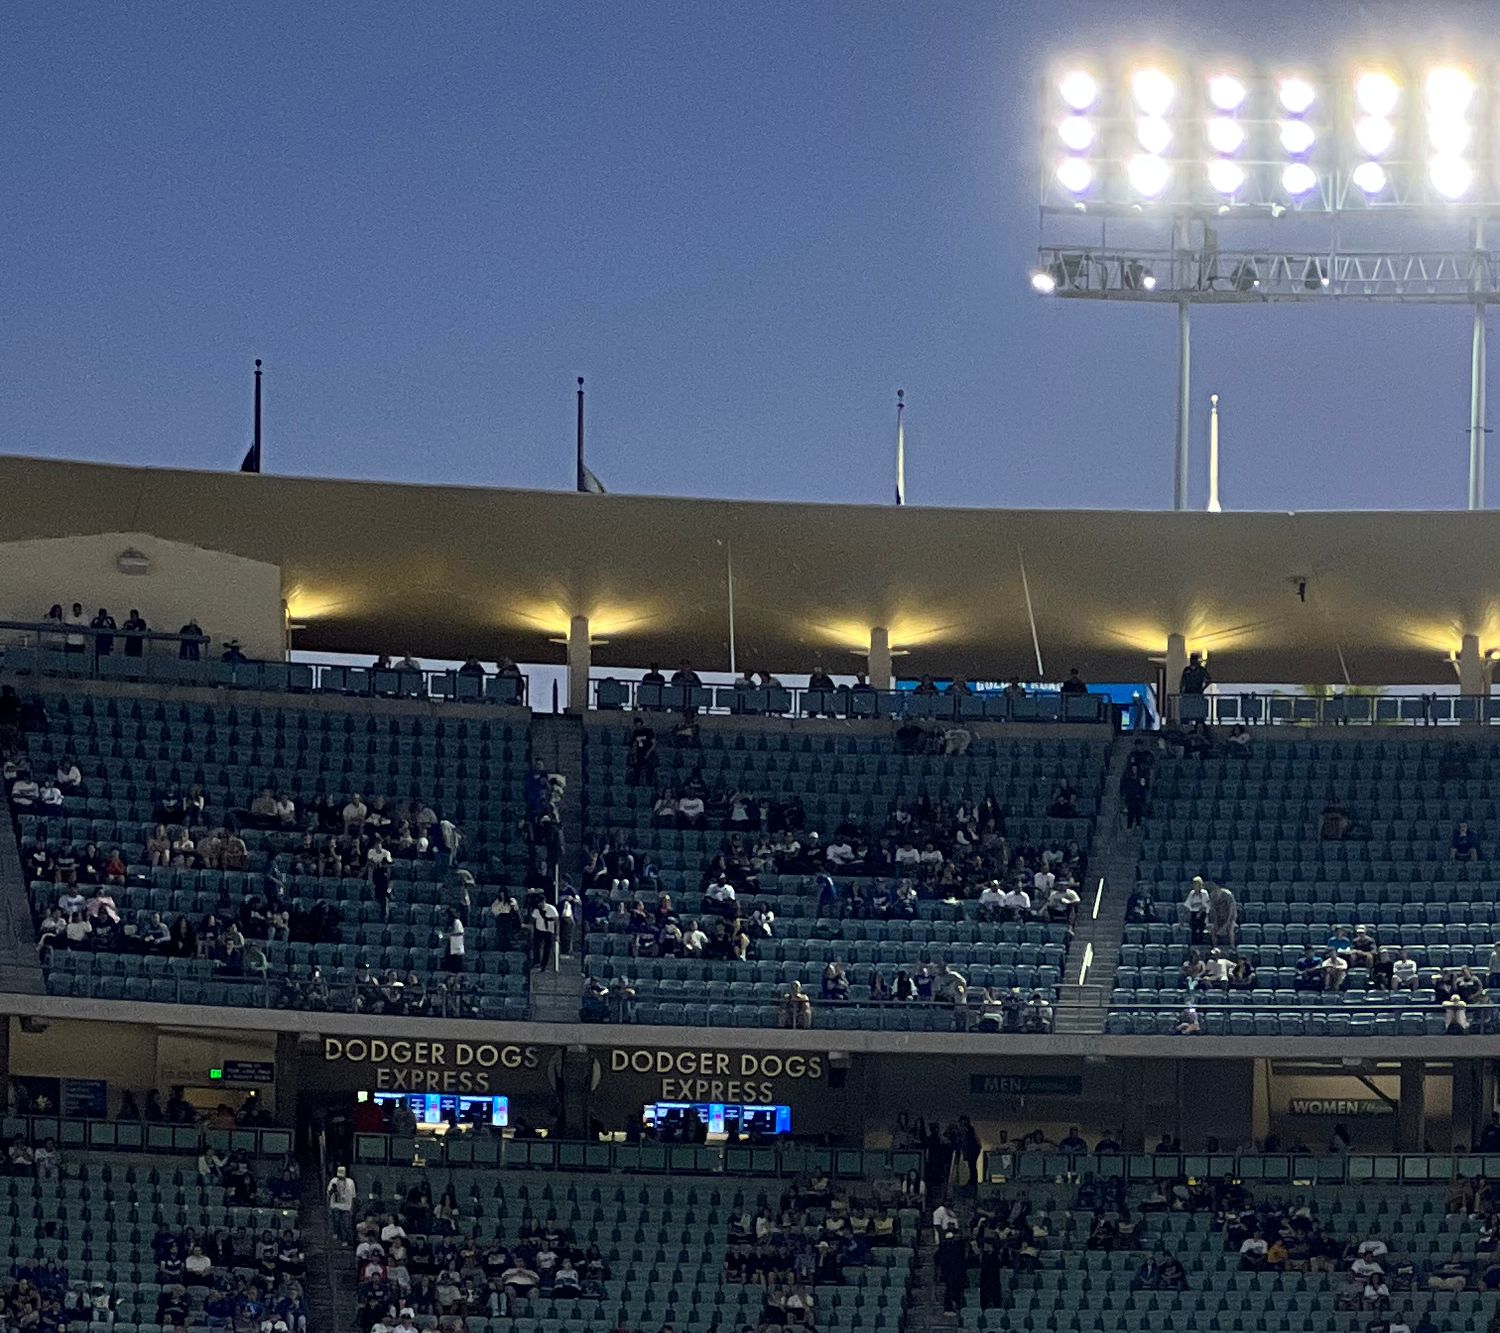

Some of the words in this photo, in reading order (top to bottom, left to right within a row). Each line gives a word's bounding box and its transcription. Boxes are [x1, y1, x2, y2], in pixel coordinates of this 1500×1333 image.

[325, 1038, 446, 1065] DODGER
[456, 1043, 539, 1068] DOGS
[611, 1049, 731, 1075] DODGER
[741, 1053, 822, 1079] DOGS
[376, 1067, 490, 1092] EXPRESS
[661, 1078, 774, 1104] EXPRESS
[1293, 1100, 1358, 1115] WOMEN
